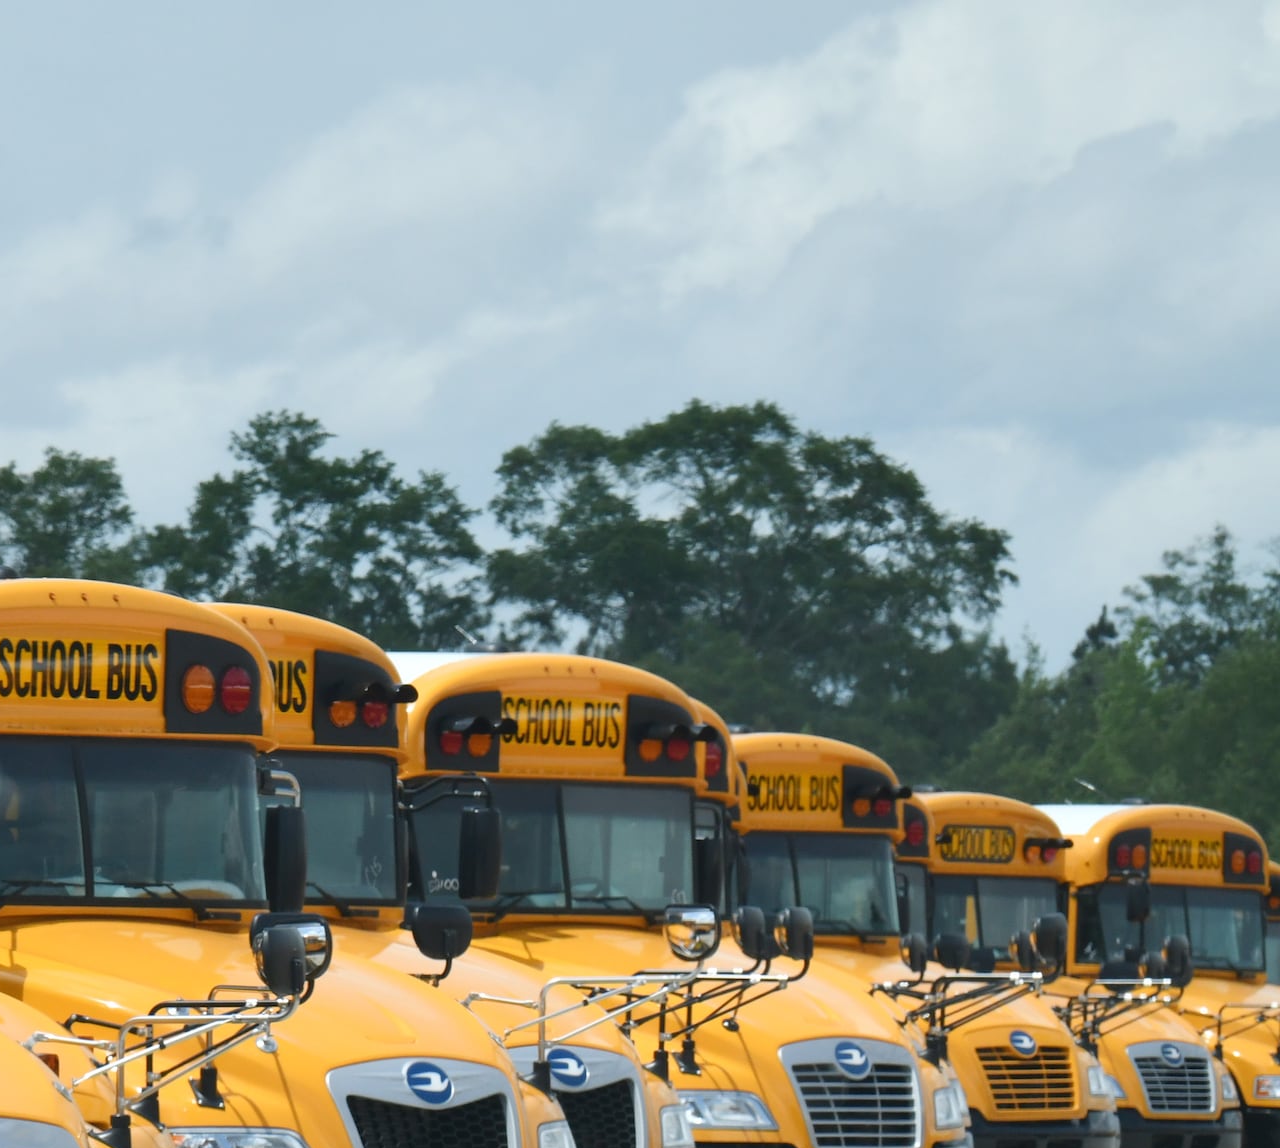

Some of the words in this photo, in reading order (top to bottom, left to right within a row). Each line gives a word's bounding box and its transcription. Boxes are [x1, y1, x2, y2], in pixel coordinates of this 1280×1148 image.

[106, 643, 158, 702] BUS
[502, 696, 577, 747] SCHOOL
[582, 701, 622, 749] BUS
[747, 774, 804, 812] SCHOOL
[809, 775, 841, 812] BUS
[990, 828, 1014, 862] BUS
[1151, 837, 1195, 870] SCHOOL
[1198, 841, 1220, 871] BUS
